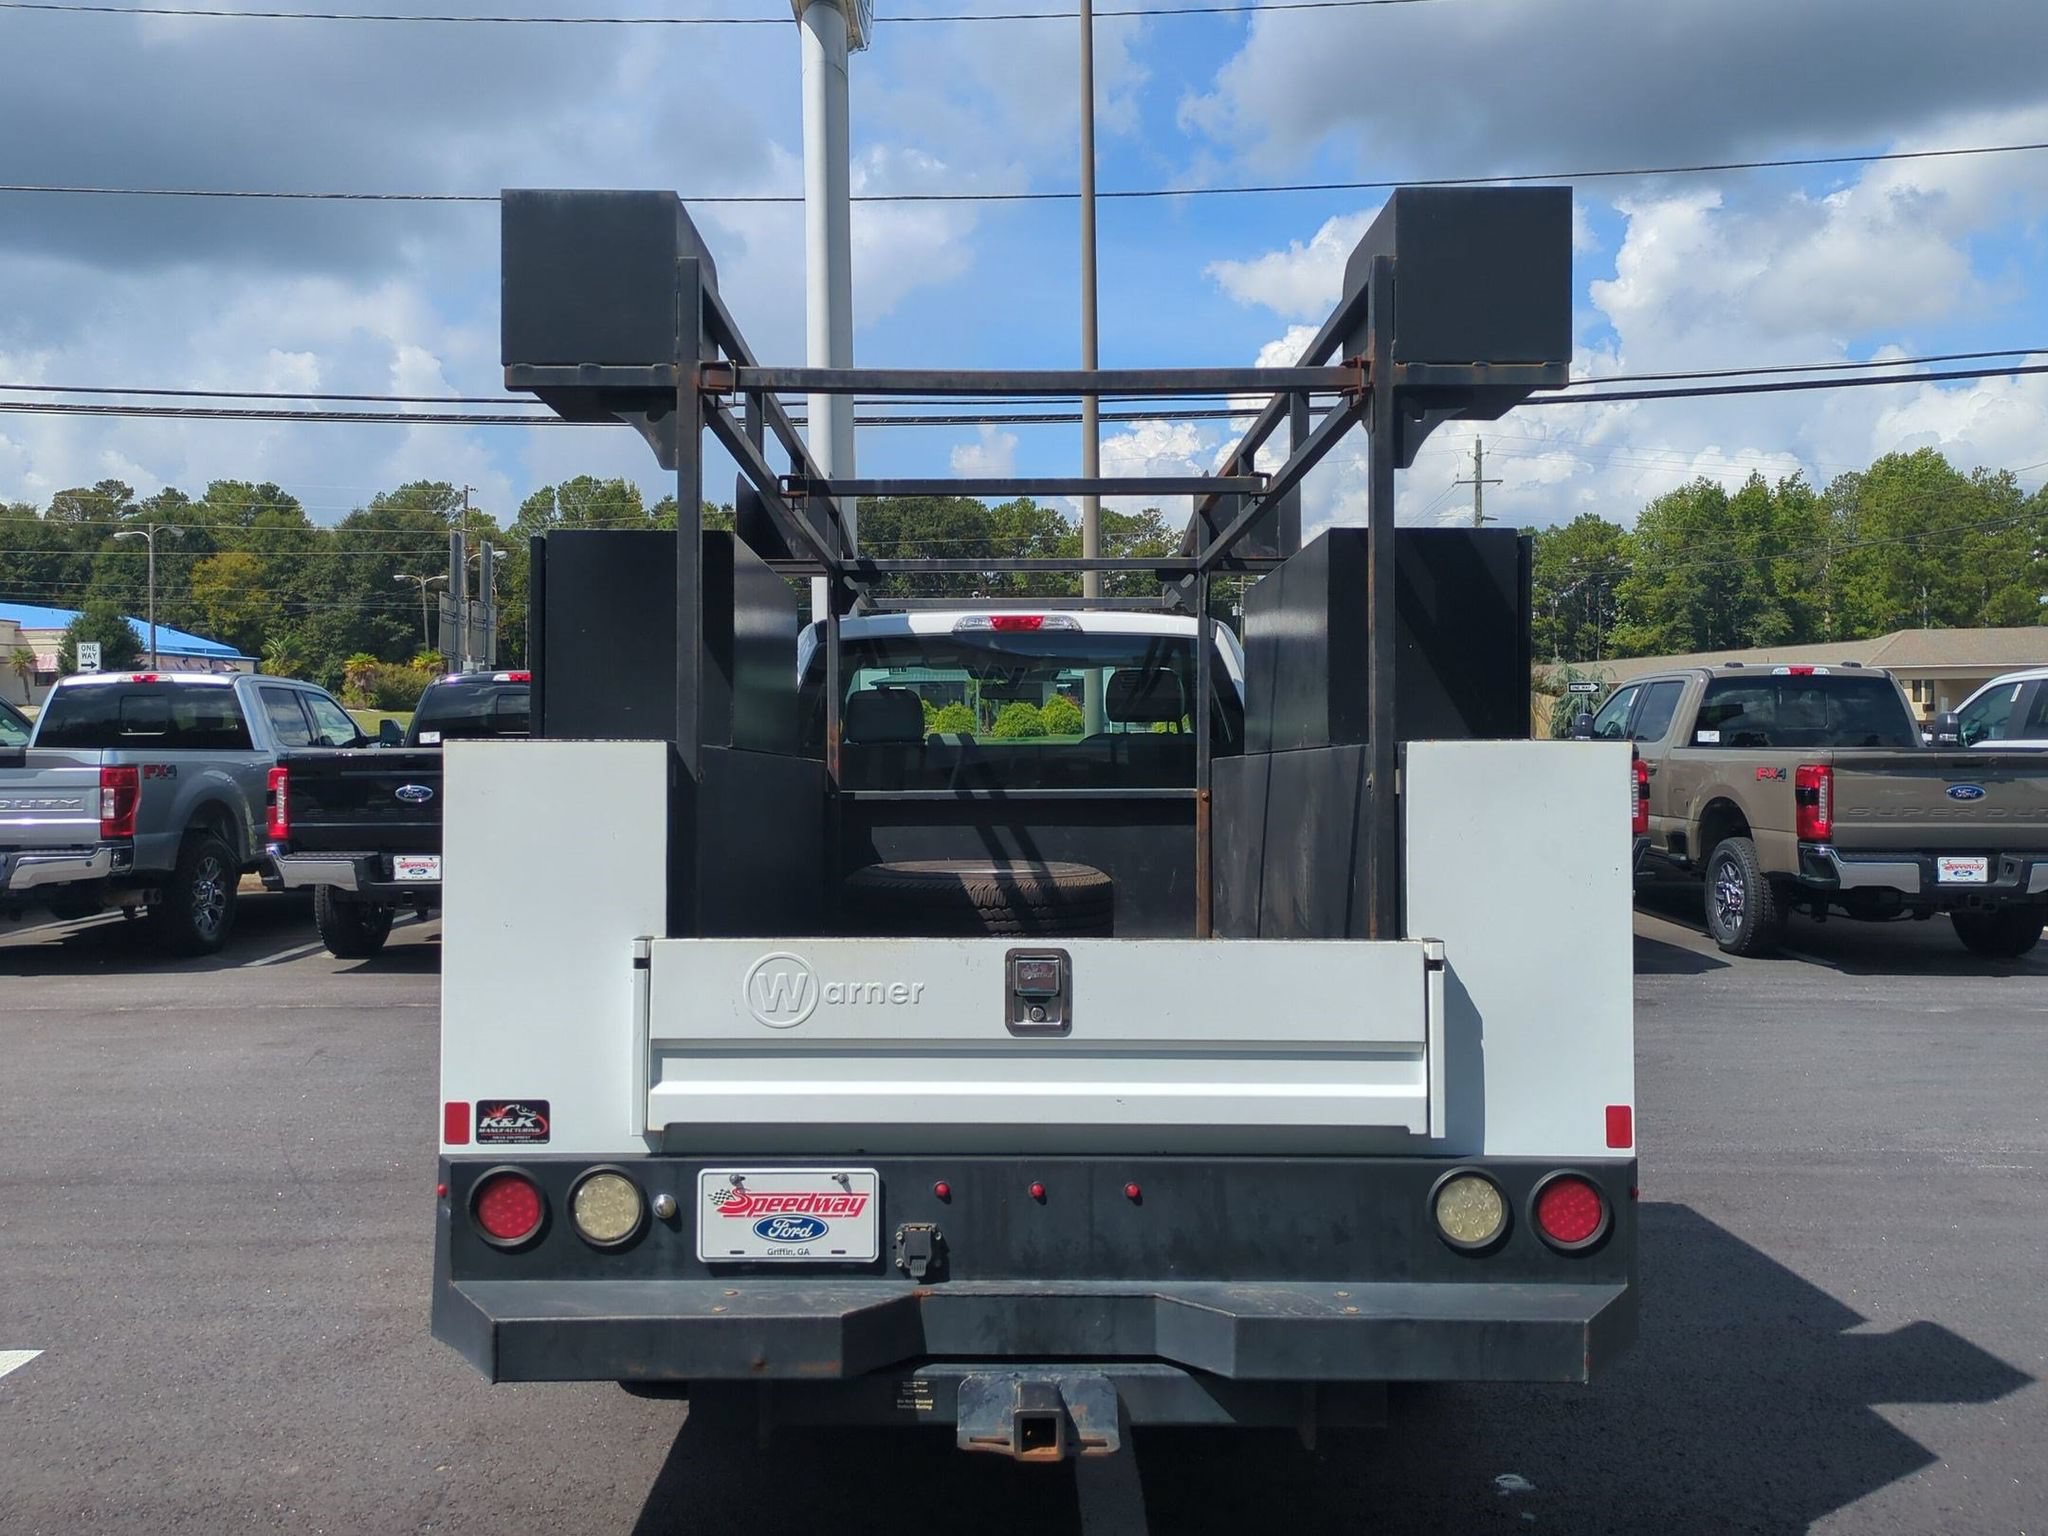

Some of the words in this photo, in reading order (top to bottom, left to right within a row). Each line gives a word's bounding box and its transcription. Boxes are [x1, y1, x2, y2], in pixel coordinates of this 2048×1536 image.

[81, 652, 97, 660] WAY
[144, 764, 178, 780] FX4
[1756, 767, 1787, 781] FX4
[1955, 787, 1978, 798] Ford
[1848, 807, 1977, 818] SUPER
[755, 970, 926, 1014] Warner
[480, 1116, 537, 1128] K&K
[716, 1188, 871, 1218] Speedway
[767, 1218, 814, 1238] Ford
[797, 1248, 811, 1256] GA
